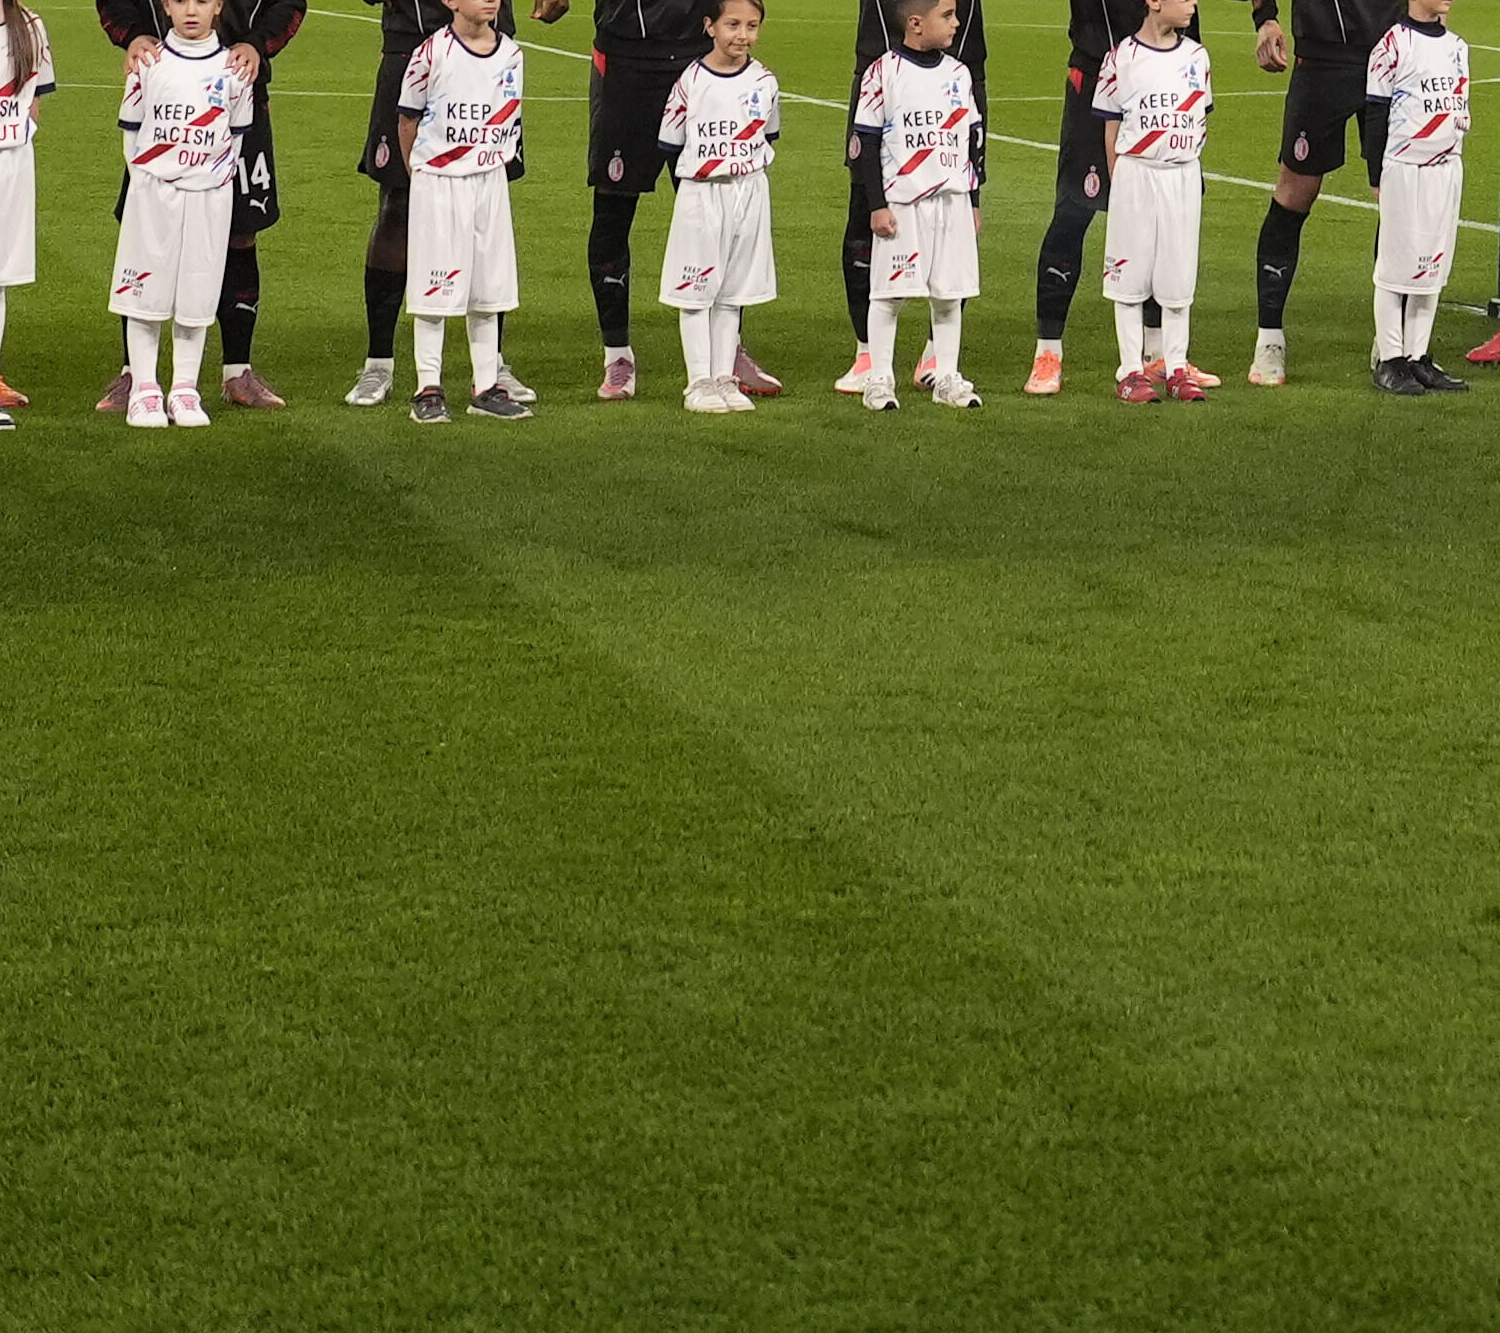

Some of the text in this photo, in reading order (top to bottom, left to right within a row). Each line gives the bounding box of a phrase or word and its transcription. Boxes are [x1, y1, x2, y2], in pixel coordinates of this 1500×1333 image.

[1420, 78, 1455, 94] KEEP
[1139, 92, 1179, 110] KEEP
[153, 104, 195, 121] KEEP
[446, 102, 491, 120] KEEP
[902, 110, 944, 129] KEEP
[698, 121, 739, 137] KEEP
[1140, 113, 1195, 129] RACISM
[153, 127, 215, 145] RACISM
[446, 126, 509, 145] RACISM
[905, 131, 959, 148] RACISM
[1169, 133, 1195, 150] OUT
[178, 150, 212, 167] OUT
[698, 142, 759, 158] RACISM
[938, 151, 959, 168] OUT
[237, 151, 271, 195] 14
